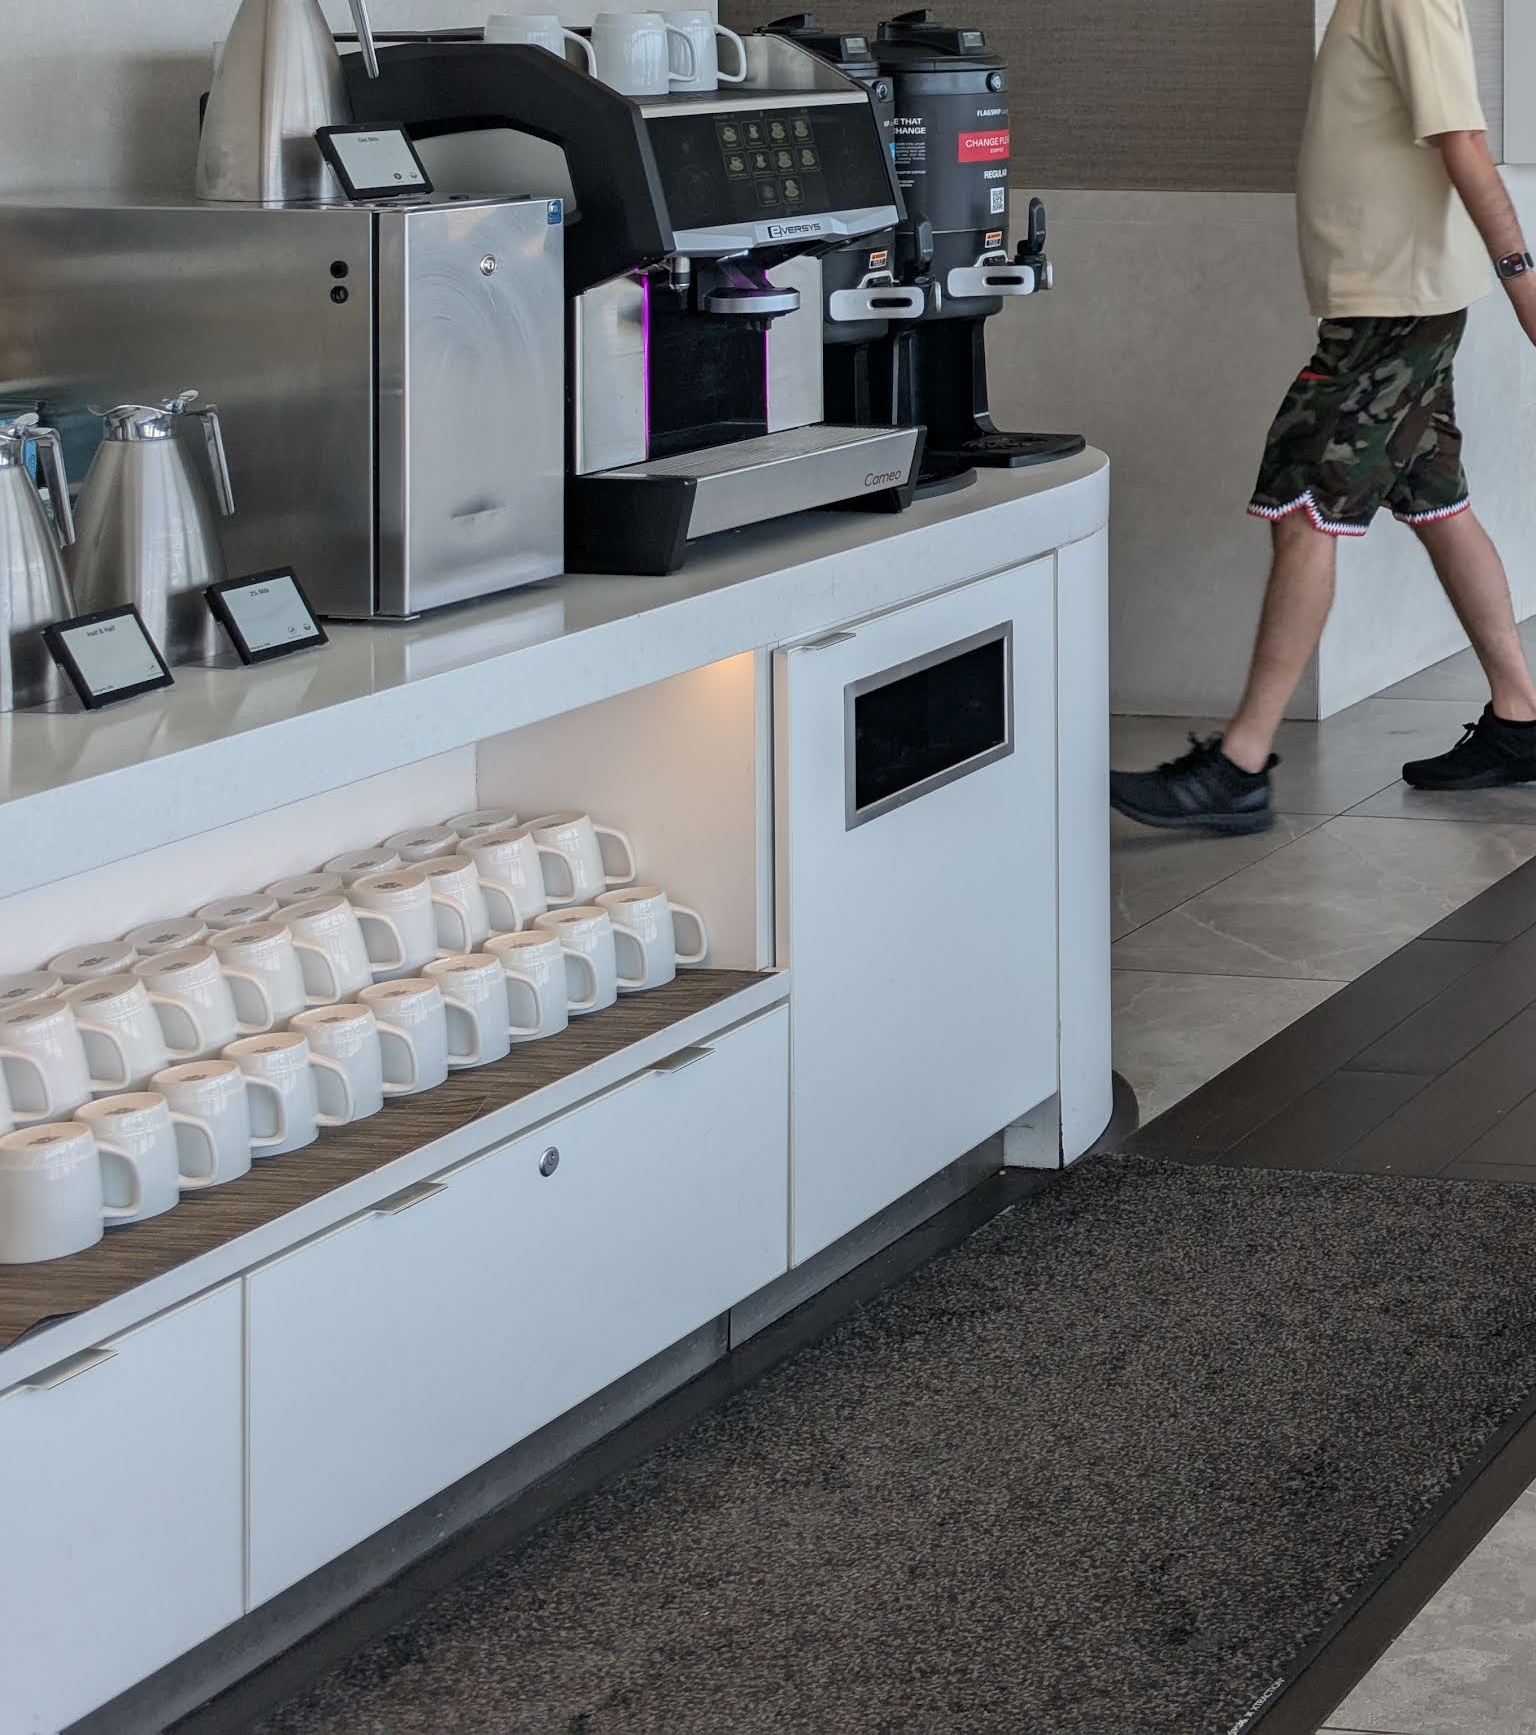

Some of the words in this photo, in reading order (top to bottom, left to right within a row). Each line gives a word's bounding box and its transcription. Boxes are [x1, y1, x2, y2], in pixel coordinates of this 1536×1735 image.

[976, 108, 1002, 117] FLAGSHIP
[966, 137, 999, 148] CHANGE
[984, 168, 1008, 180] REGULAR
[864, 470, 902, 486] Cameo
